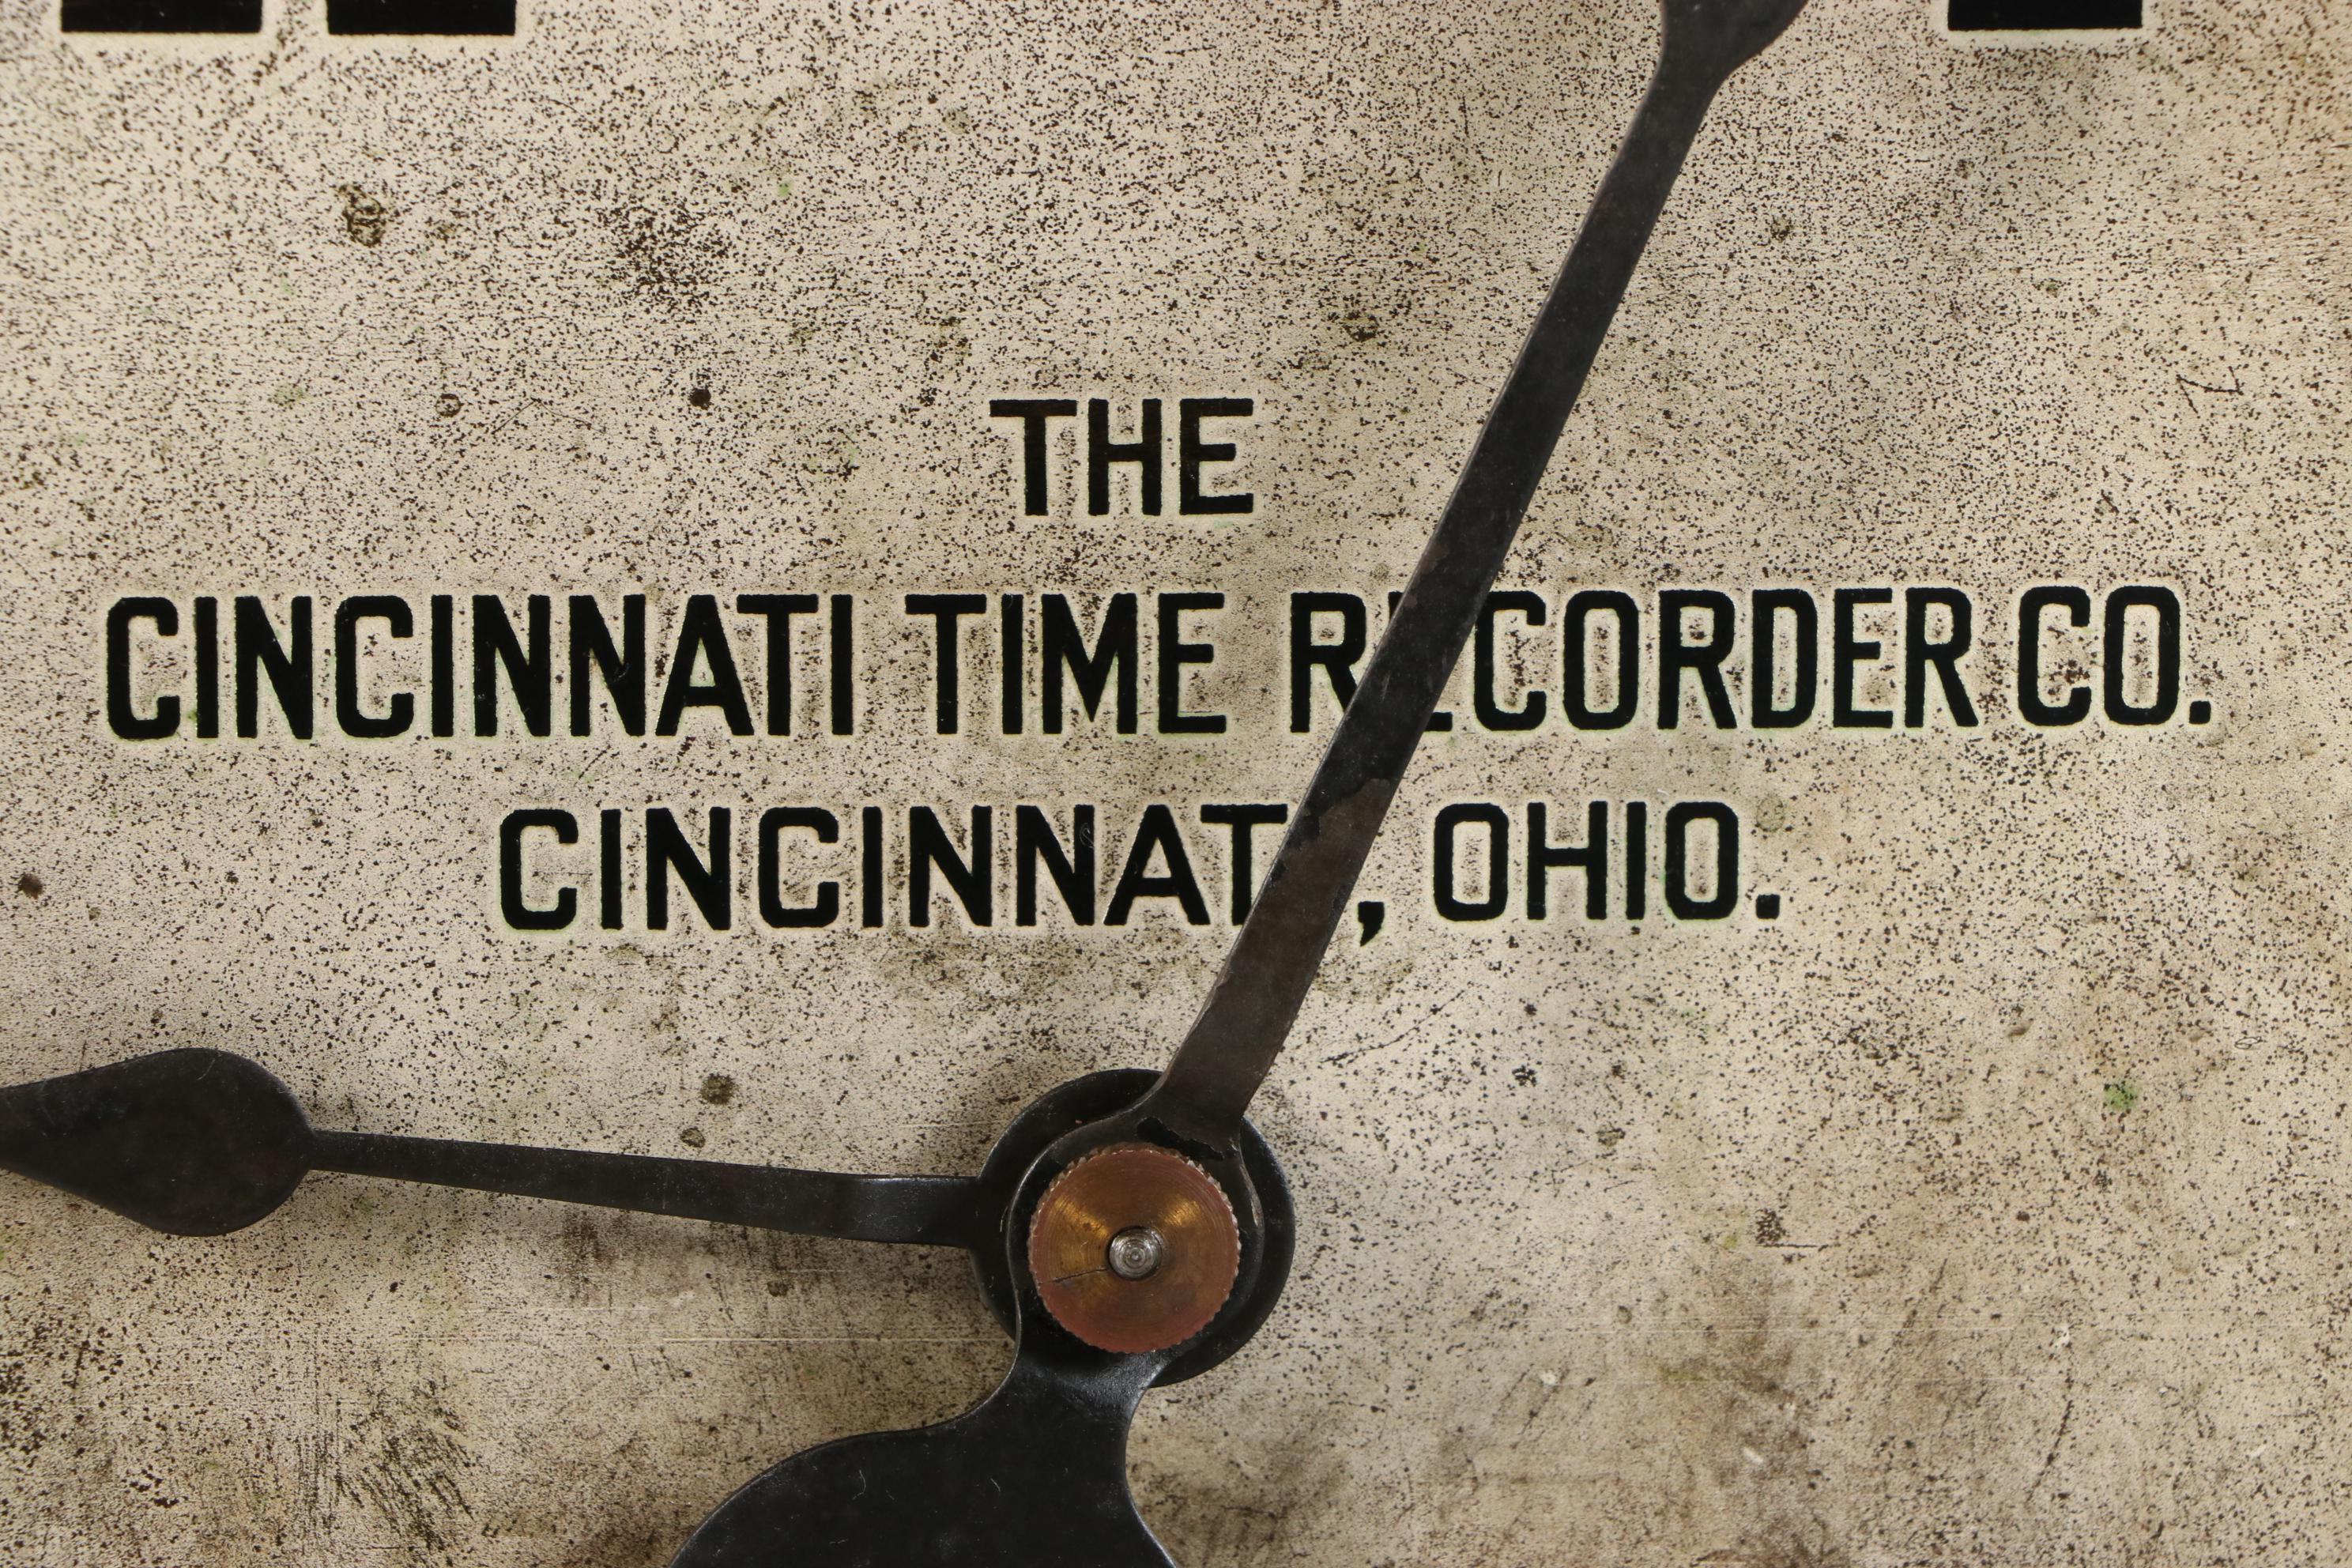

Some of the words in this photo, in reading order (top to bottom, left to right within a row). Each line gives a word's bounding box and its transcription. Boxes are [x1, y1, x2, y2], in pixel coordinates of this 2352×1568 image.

[989, 397, 1254, 517] THE
[106, 594, 854, 741] CINCINNATI
[904, 592, 1227, 736] TIME
[1289, 587, 1979, 733] RCORDER
[2017, 585, 2212, 727] CO.
[499, 804, 1385, 947] CINCINNAT,
[1432, 801, 1781, 922] OHIO.
